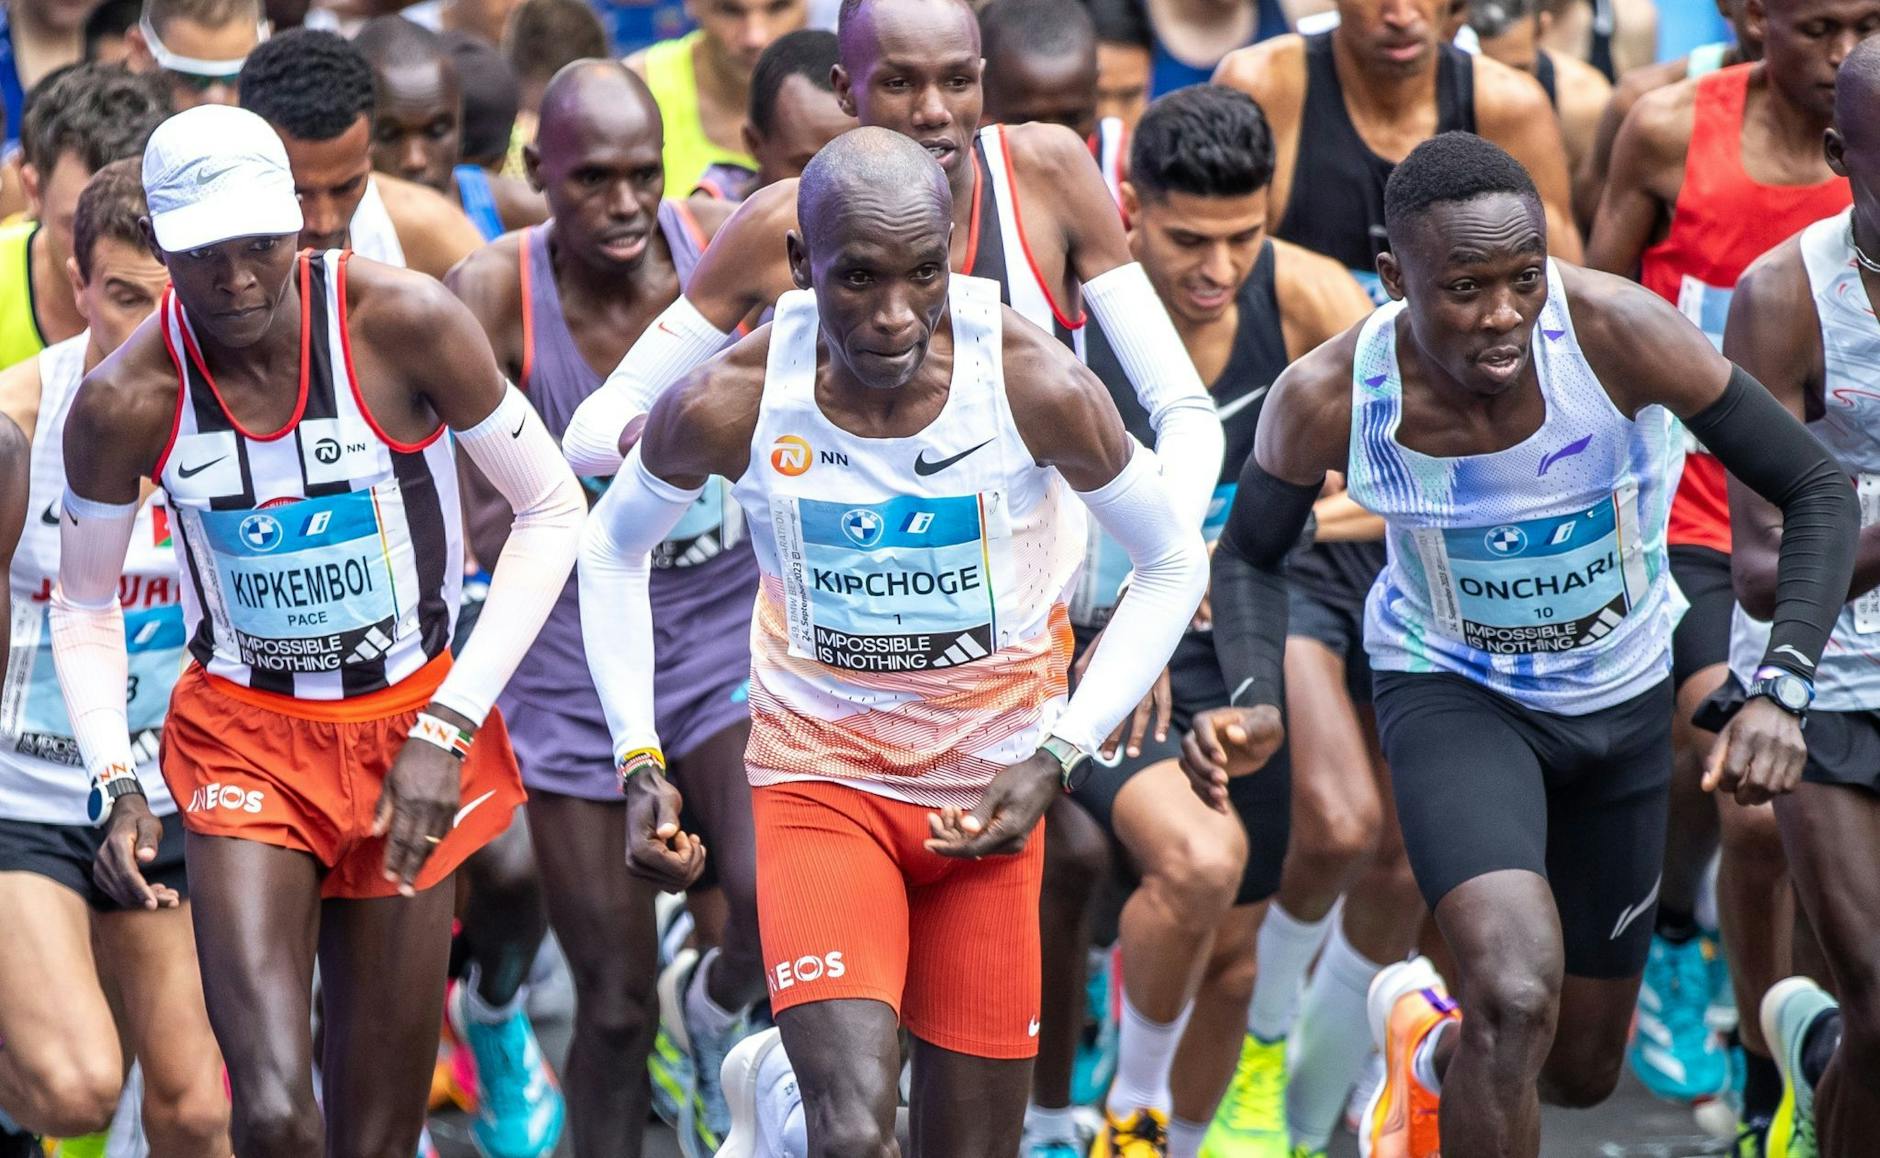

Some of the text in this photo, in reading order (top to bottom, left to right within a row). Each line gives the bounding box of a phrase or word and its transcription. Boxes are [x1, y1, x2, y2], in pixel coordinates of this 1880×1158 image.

[346, 442, 366, 453] NN
[820, 450, 849, 467] NN
[231, 555, 373, 609] KIPKEMBOI
[813, 565, 981, 597] KIPCHOGE
[1459, 551, 1614, 600] ONCHARI
[287, 611, 328, 627] PACE
[893, 613, 902, 625] 1
[1533, 607, 1554, 619] 10
[817, 627, 931, 654] IMPOSSIBLE
[1465, 621, 1578, 641] IMPOSSIBLE
[238, 633, 343, 655] IMPOSSIBLE
[1467, 636, 1575, 655] IS NOTHING
[241, 651, 341, 672] IS NOTHING
[818, 646, 928, 670] IS NOTHING
[186, 782, 265, 814] INEOS
[767, 950, 846, 995] NEOS
